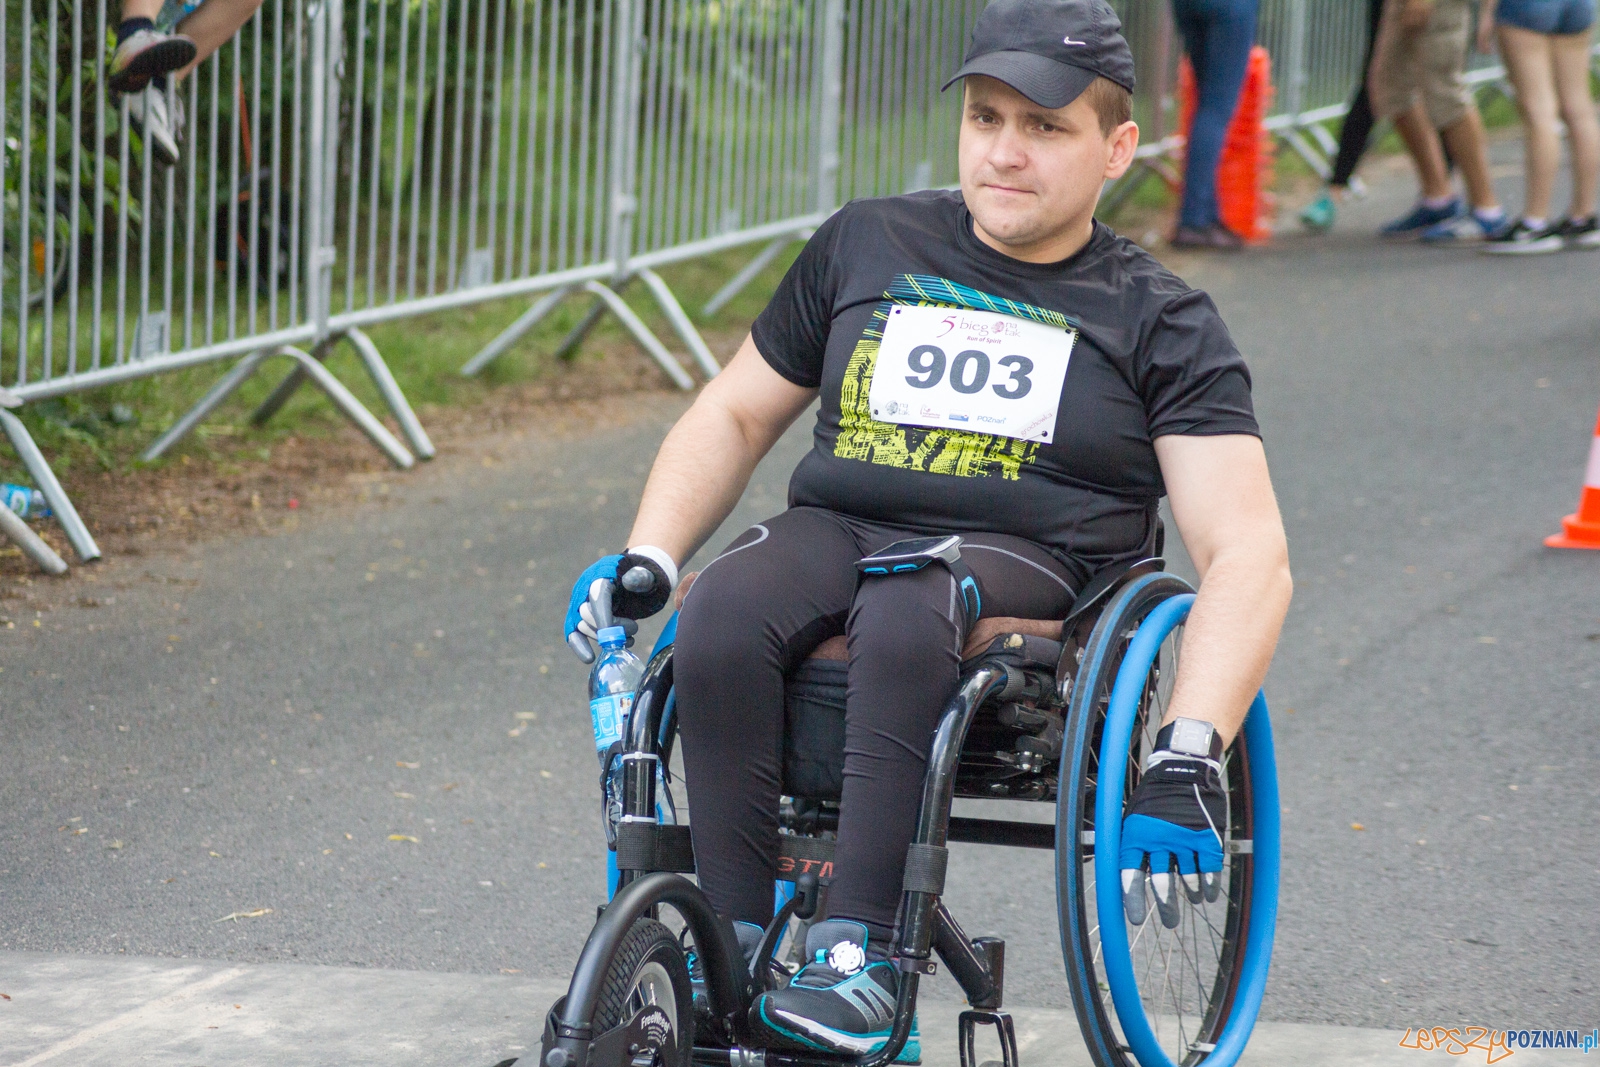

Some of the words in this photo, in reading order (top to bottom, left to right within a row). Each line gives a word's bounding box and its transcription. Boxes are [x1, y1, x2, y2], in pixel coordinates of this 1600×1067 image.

[936, 315, 957, 338] 5
[960, 317, 989, 337] bieg
[1005, 321, 1018, 329] na
[1004, 328, 1021, 338] tak
[986, 337, 1002, 345] Spirit
[905, 344, 1034, 399] 903
